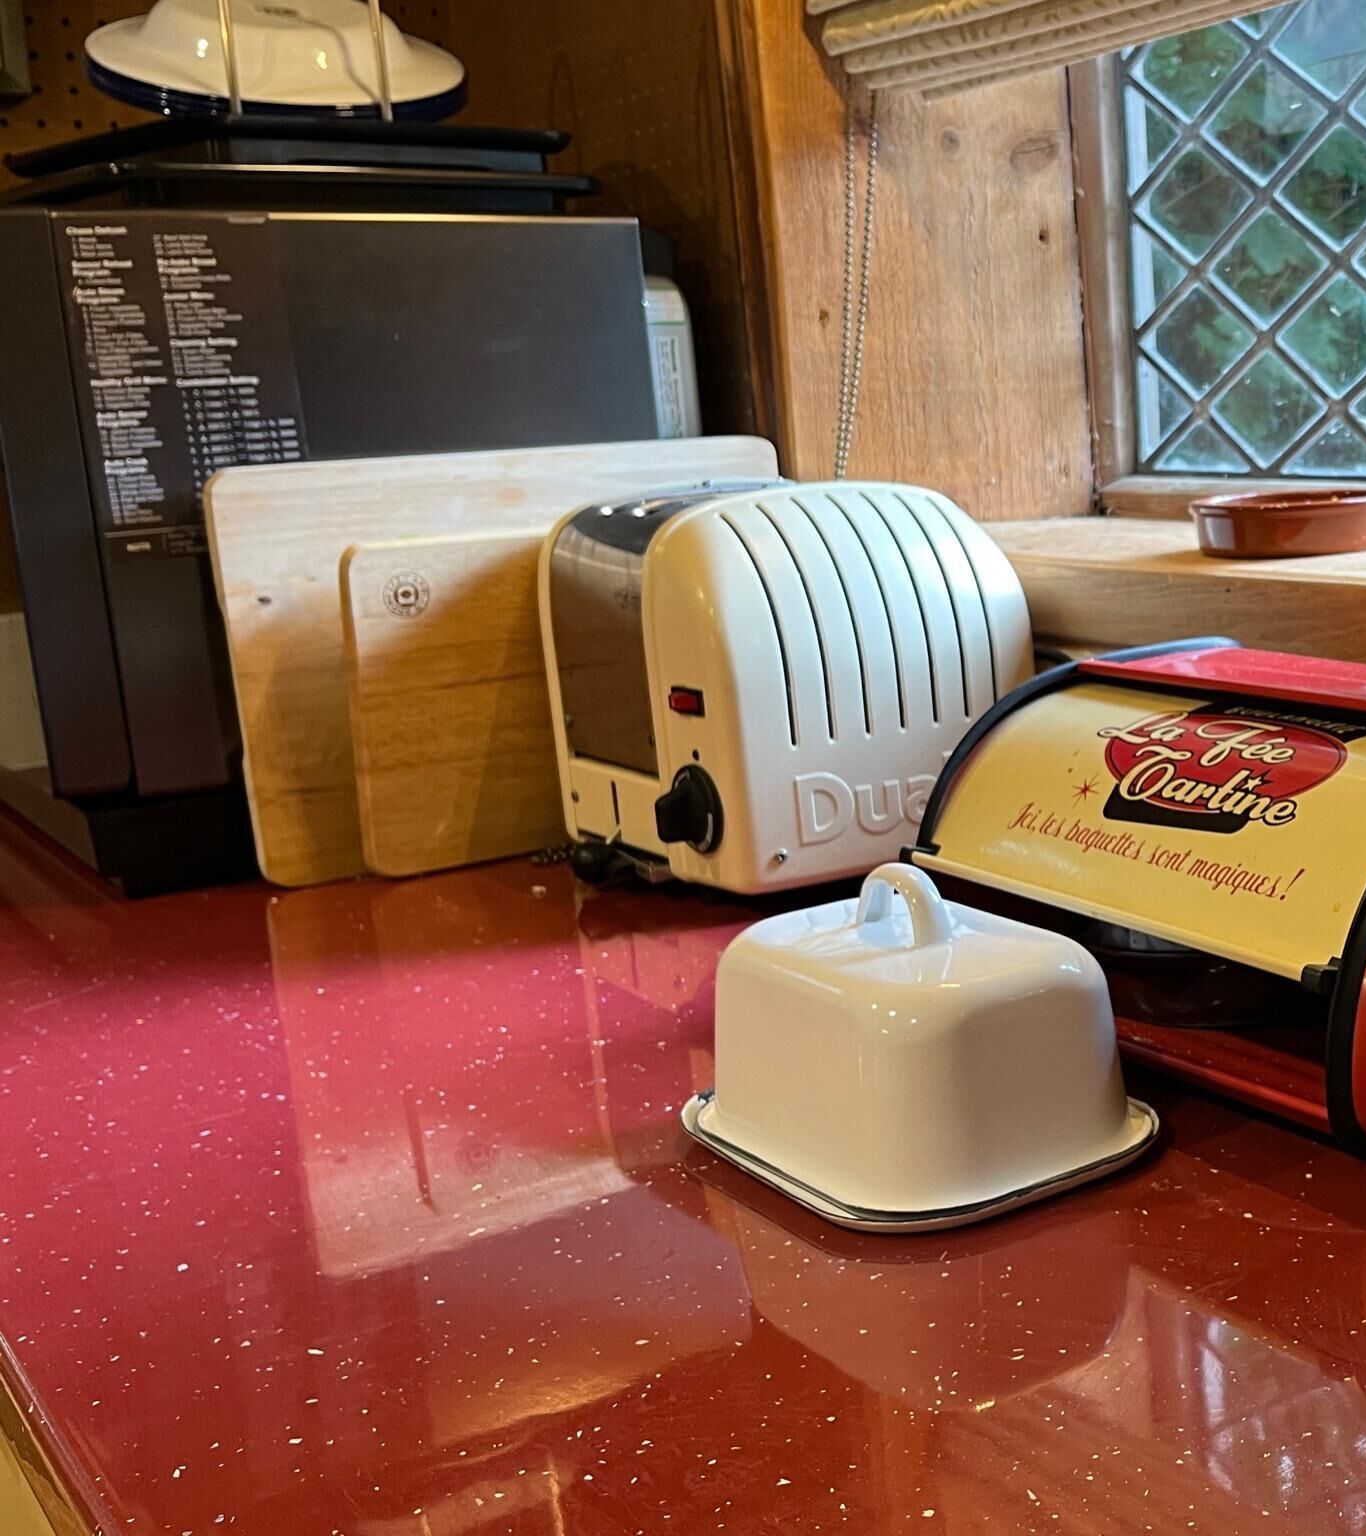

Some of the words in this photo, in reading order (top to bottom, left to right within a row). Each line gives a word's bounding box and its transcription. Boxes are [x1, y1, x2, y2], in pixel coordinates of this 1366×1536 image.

[1097, 710, 1187, 745] La
[1195, 720, 1296, 766] Fée
[1119, 747, 1297, 827] Tartine
[1039, 811, 1061, 837] les
[1067, 817, 1142, 861] baguettes
[1148, 846, 1192, 871] sont
